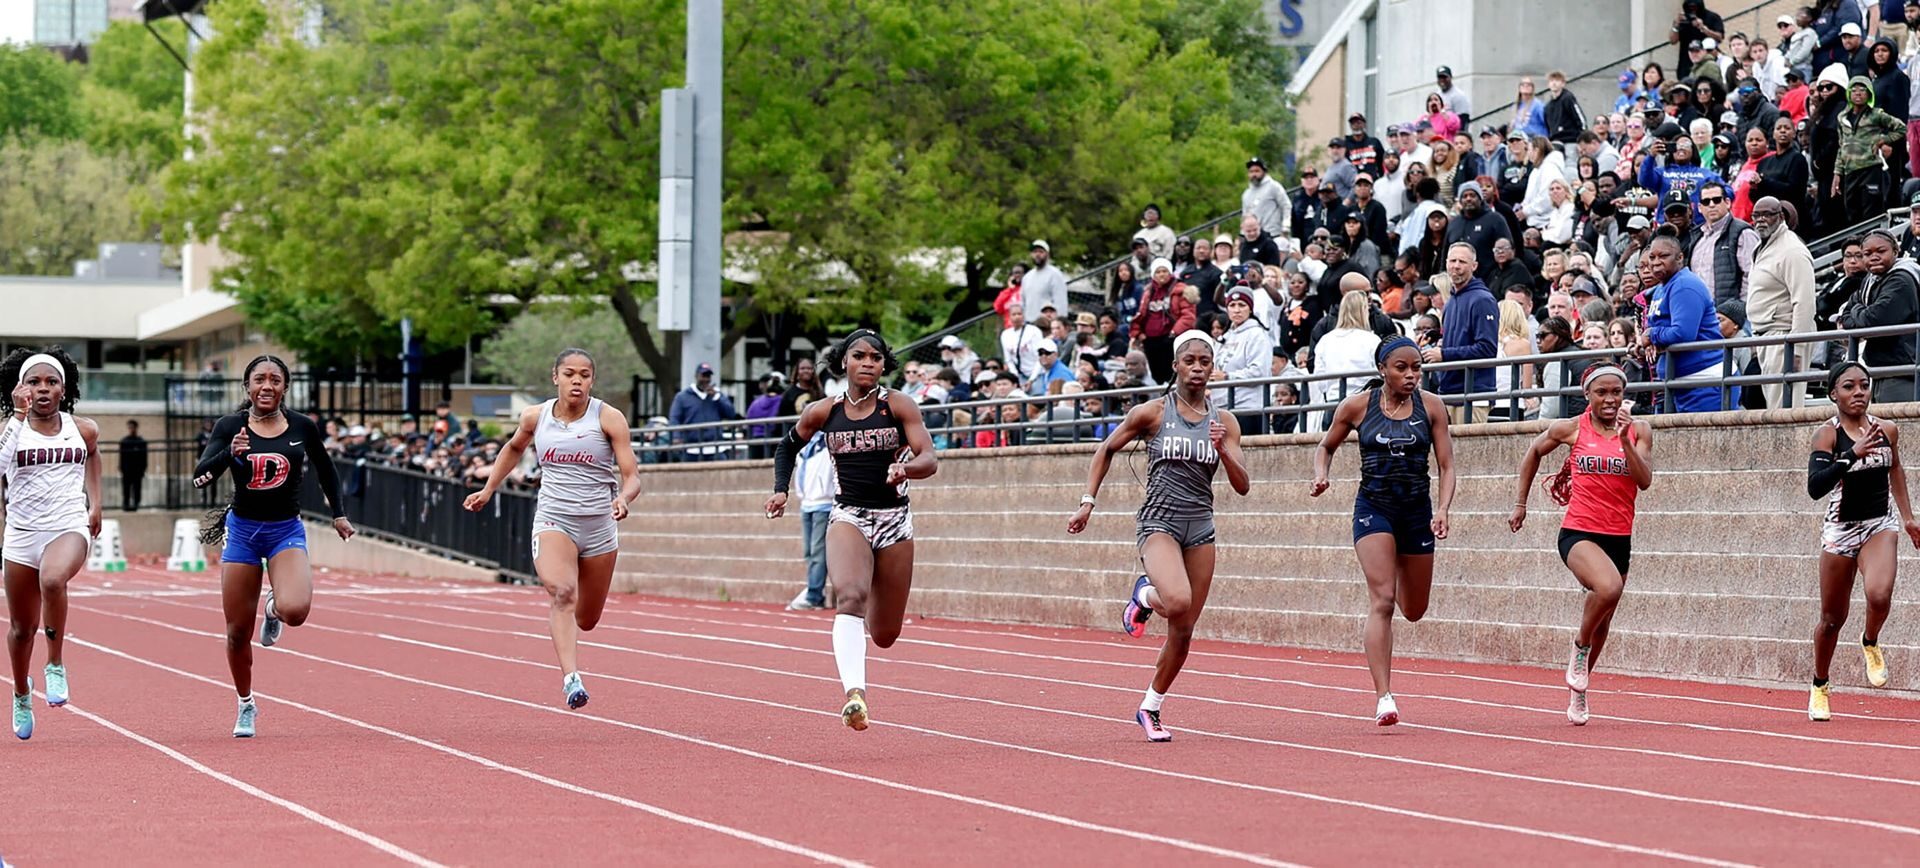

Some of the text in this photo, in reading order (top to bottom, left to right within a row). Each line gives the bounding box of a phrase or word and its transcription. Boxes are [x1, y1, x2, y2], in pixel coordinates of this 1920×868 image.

[1279, 0, 1304, 37] S
[17, 447, 87, 468] HERITAG
[541, 447, 596, 464] Martin
[1162, 436, 1192, 461] RED
[246, 452, 291, 490] D
